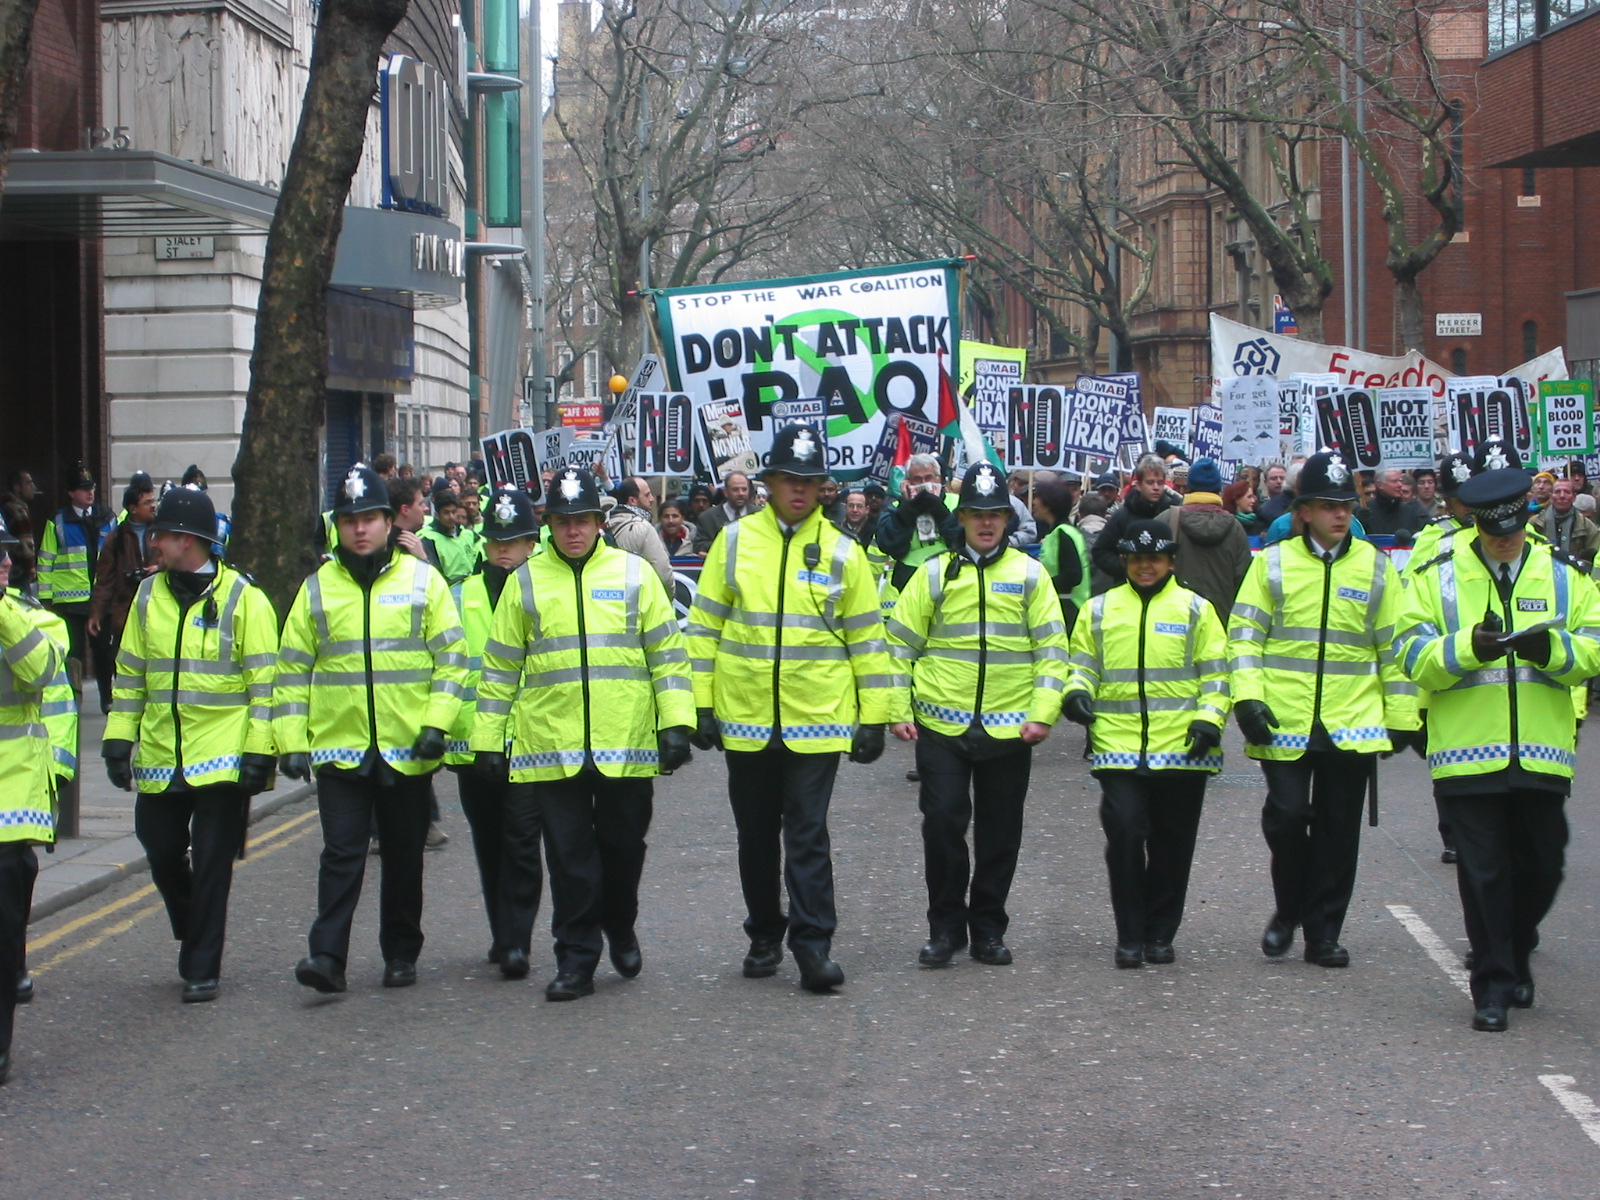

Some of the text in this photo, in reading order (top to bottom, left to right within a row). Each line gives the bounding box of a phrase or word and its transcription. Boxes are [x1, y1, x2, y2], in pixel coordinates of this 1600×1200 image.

[166, 247, 179, 258] ST
[678, 275, 942, 310] STOP THE WAR COALITION
[681, 315, 950, 374] DON'T ATTACK
[991, 363, 1017, 374] MAB
[1328, 352, 1446, 397] Freedo
[1094, 382, 1125, 396] MAB
[1229, 389, 1267, 400] For get
[976, 389, 1007, 403] ATTAC
[790, 403, 821, 413] MAB
[1074, 392, 1127, 416] DON'T
[1252, 400, 1272, 408] NHS
[1381, 399, 1428, 416] NOT
[1554, 397, 1577, 409] NO
[704, 402, 740, 421] Mirror
[976, 400, 1006, 426] IRA
[1071, 408, 1123, 428] ATTACK
[1548, 410, 1584, 422] BLOOD
[774, 416, 826, 434] DOT
[1157, 414, 1187, 426] NOT
[1381, 415, 1428, 428] IN MY
[1457, 390, 1513, 455] NO
[640, 394, 692, 473] NO
[905, 420, 935, 435] MAB
[1008, 387, 1061, 467] NO
[1156, 424, 1186, 434] IN MY
[1316, 391, 1381, 469] NO
[1381, 426, 1430, 438] NAME
[1553, 424, 1582, 435] FOR
[1066, 420, 1120, 455] IRAQ
[1155, 431, 1186, 440] NAME
[711, 434, 753, 458] NO WAR
[1381, 440, 1430, 453] DON'T
[1556, 437, 1581, 448] OIL
[1209, 444, 1222, 456] For
[482, 432, 542, 502] NO
[550, 457, 567, 470] WA
[993, 583, 1022, 593] POLICE
[1340, 588, 1367, 600] POLICE
[593, 591, 623, 599] POLICE
